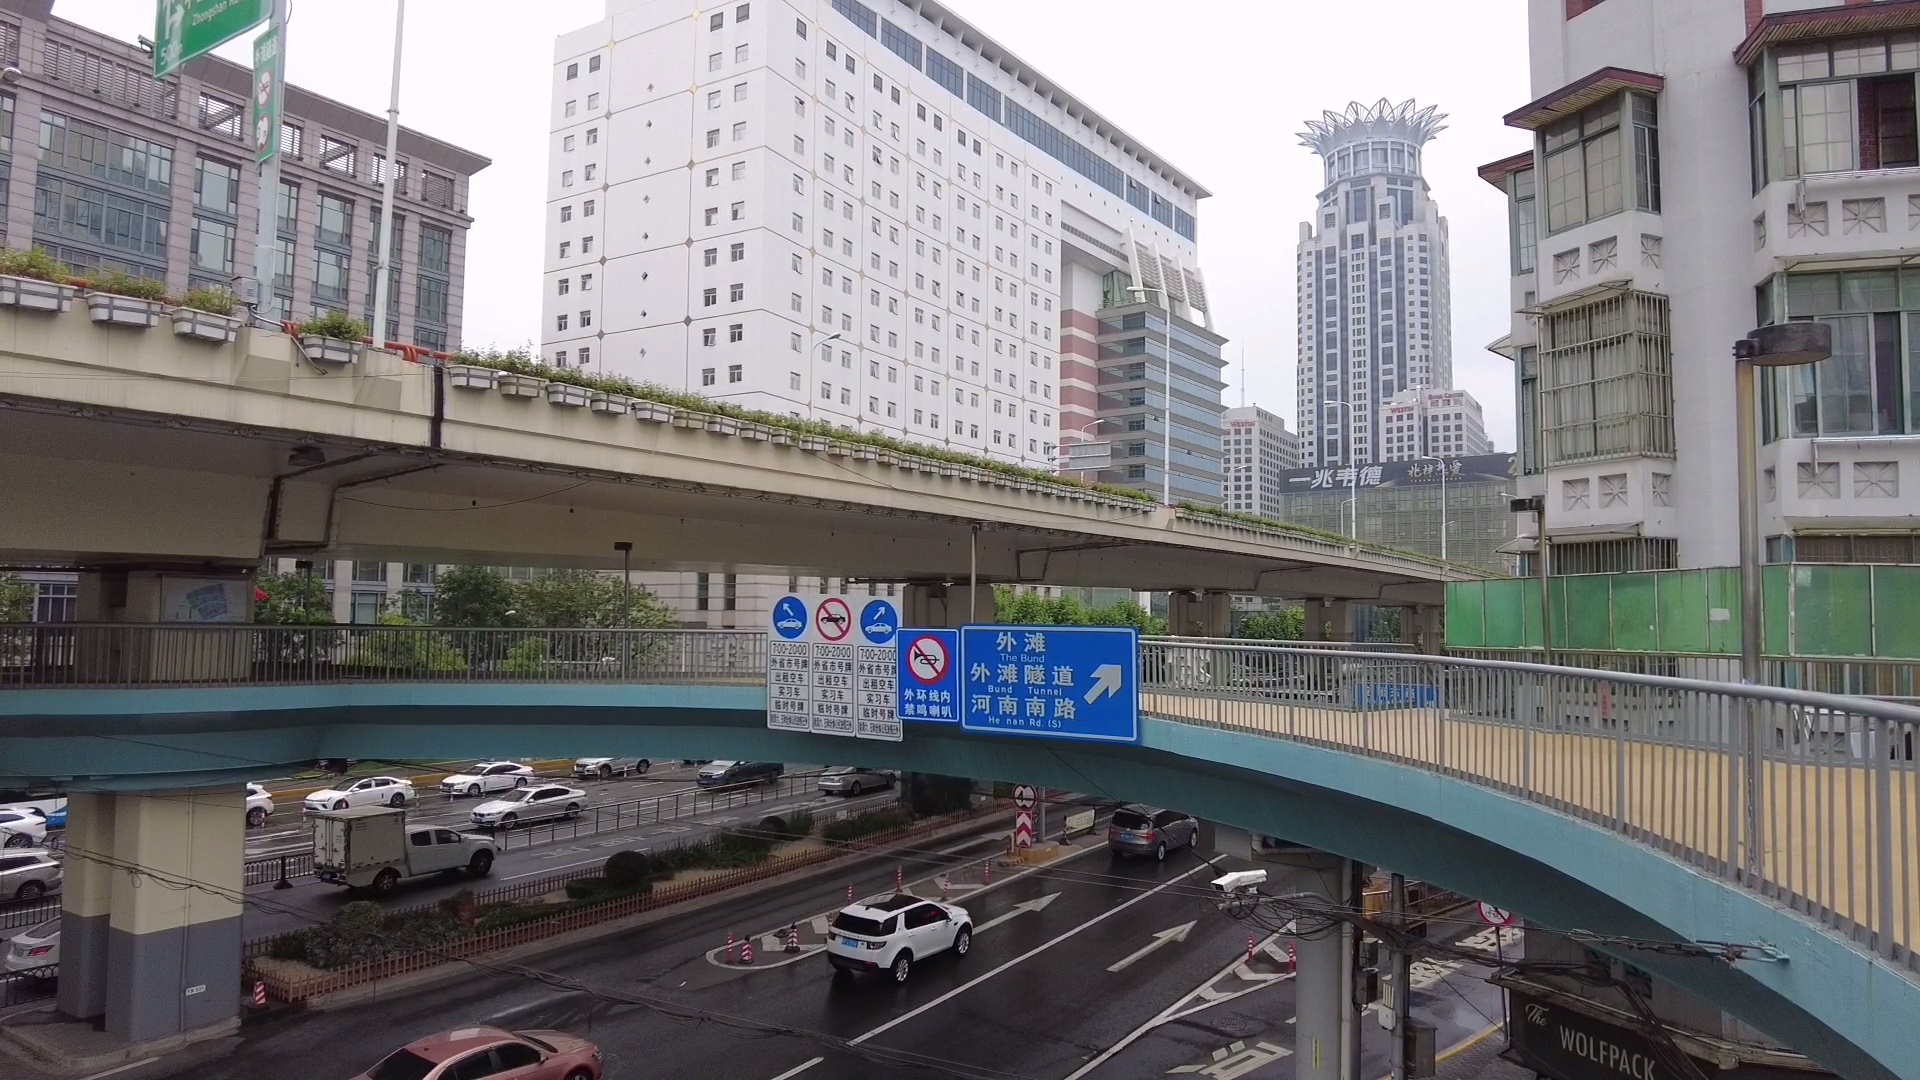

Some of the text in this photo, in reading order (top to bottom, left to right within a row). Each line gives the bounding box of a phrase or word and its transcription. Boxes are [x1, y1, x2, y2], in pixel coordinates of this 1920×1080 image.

[1288, 465, 1383, 489] 一兆韦德
[996, 632, 1046, 653] 外滩
[770, 658, 808, 670] 外省市号牌
[1000, 654, 1045, 663] The Bund
[813, 660, 852, 672] 外省市号牌
[774, 672, 804, 684] 出租空车
[817, 675, 848, 687] 出租空车
[970, 663, 1074, 687] 外滩隧道
[863, 678, 895, 691] 出租空车
[988, 685, 1062, 696] Bund Tunnel
[778, 686, 801, 697] 实习车
[821, 689, 844, 700] 实习车
[903, 688, 951, 703] 外环线内
[866, 693, 890, 705] 实习车
[904, 703, 952, 718] 禁鸣喇叭
[970, 694, 1076, 719] 河南南路
[988, 715, 1062, 729] He nan Rd. (S)
[1525, 1003, 1550, 1027] The
[1559, 1024, 1657, 1080] WOLFPACK
